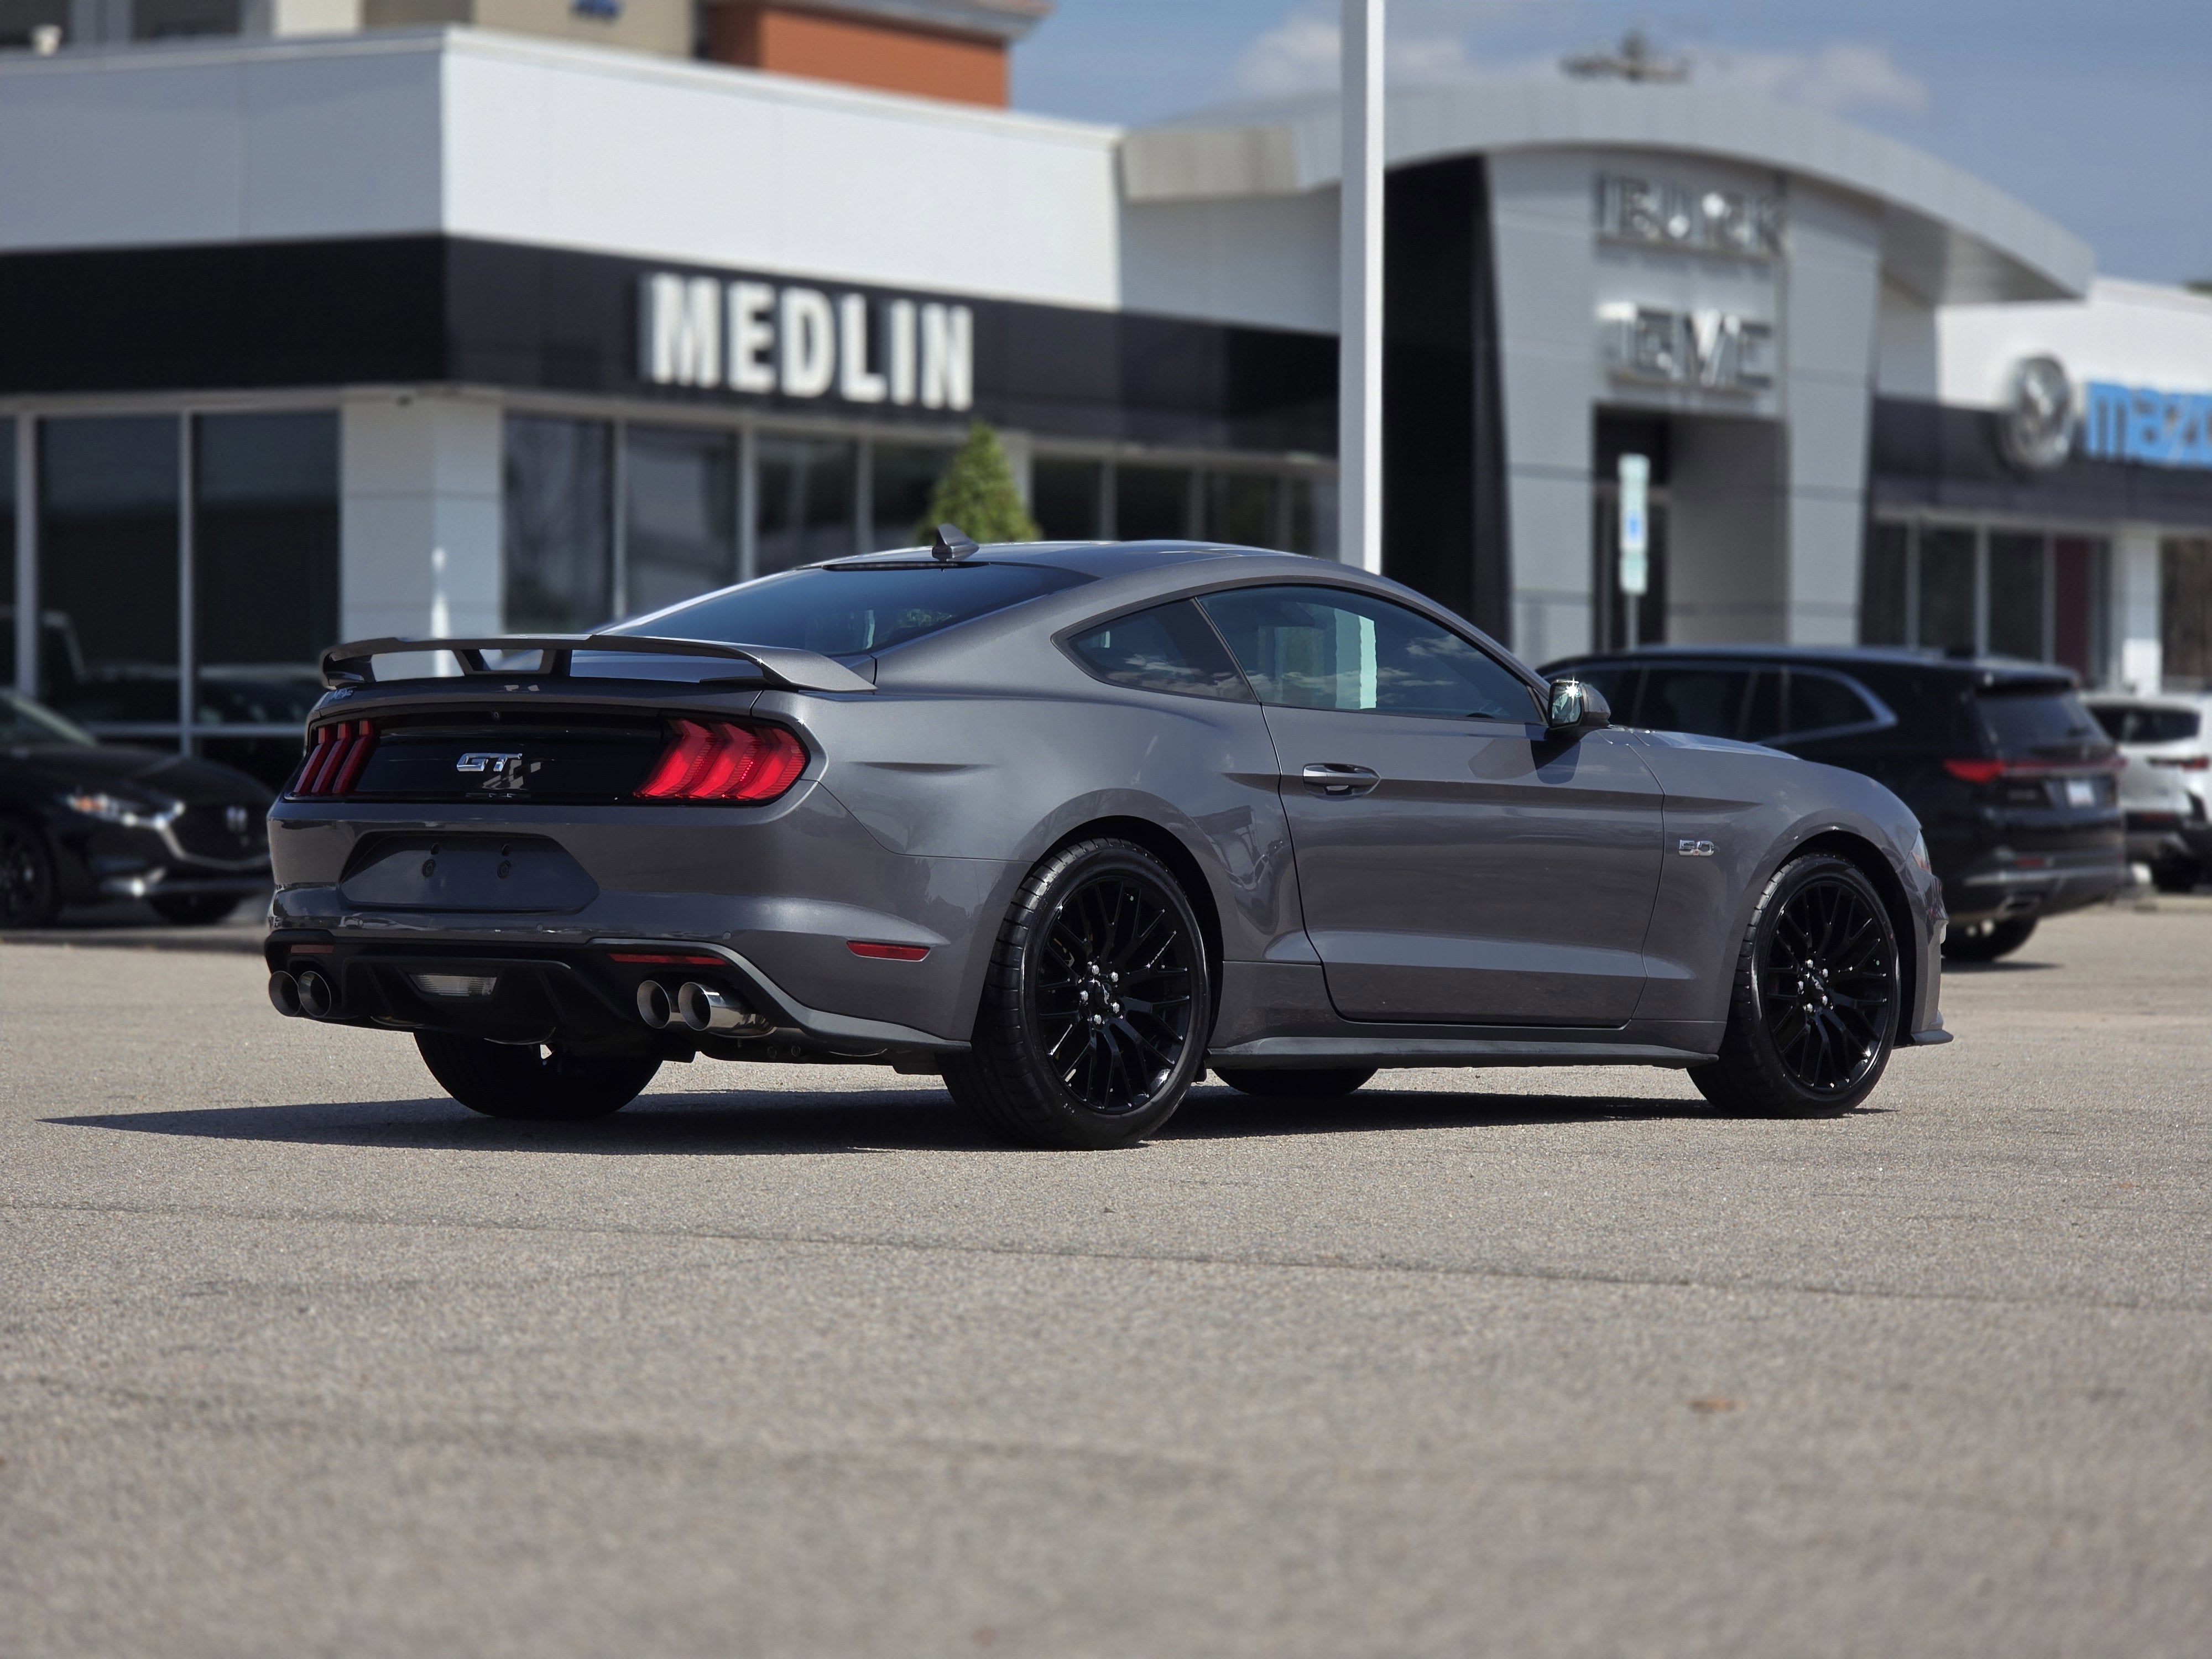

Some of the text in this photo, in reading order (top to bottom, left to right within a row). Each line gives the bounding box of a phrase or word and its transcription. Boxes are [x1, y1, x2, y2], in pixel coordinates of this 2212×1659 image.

[648, 272, 974, 411] MEDLIN
[456, 753, 523, 772] GT
[1678, 839, 1714, 856] 5.0
